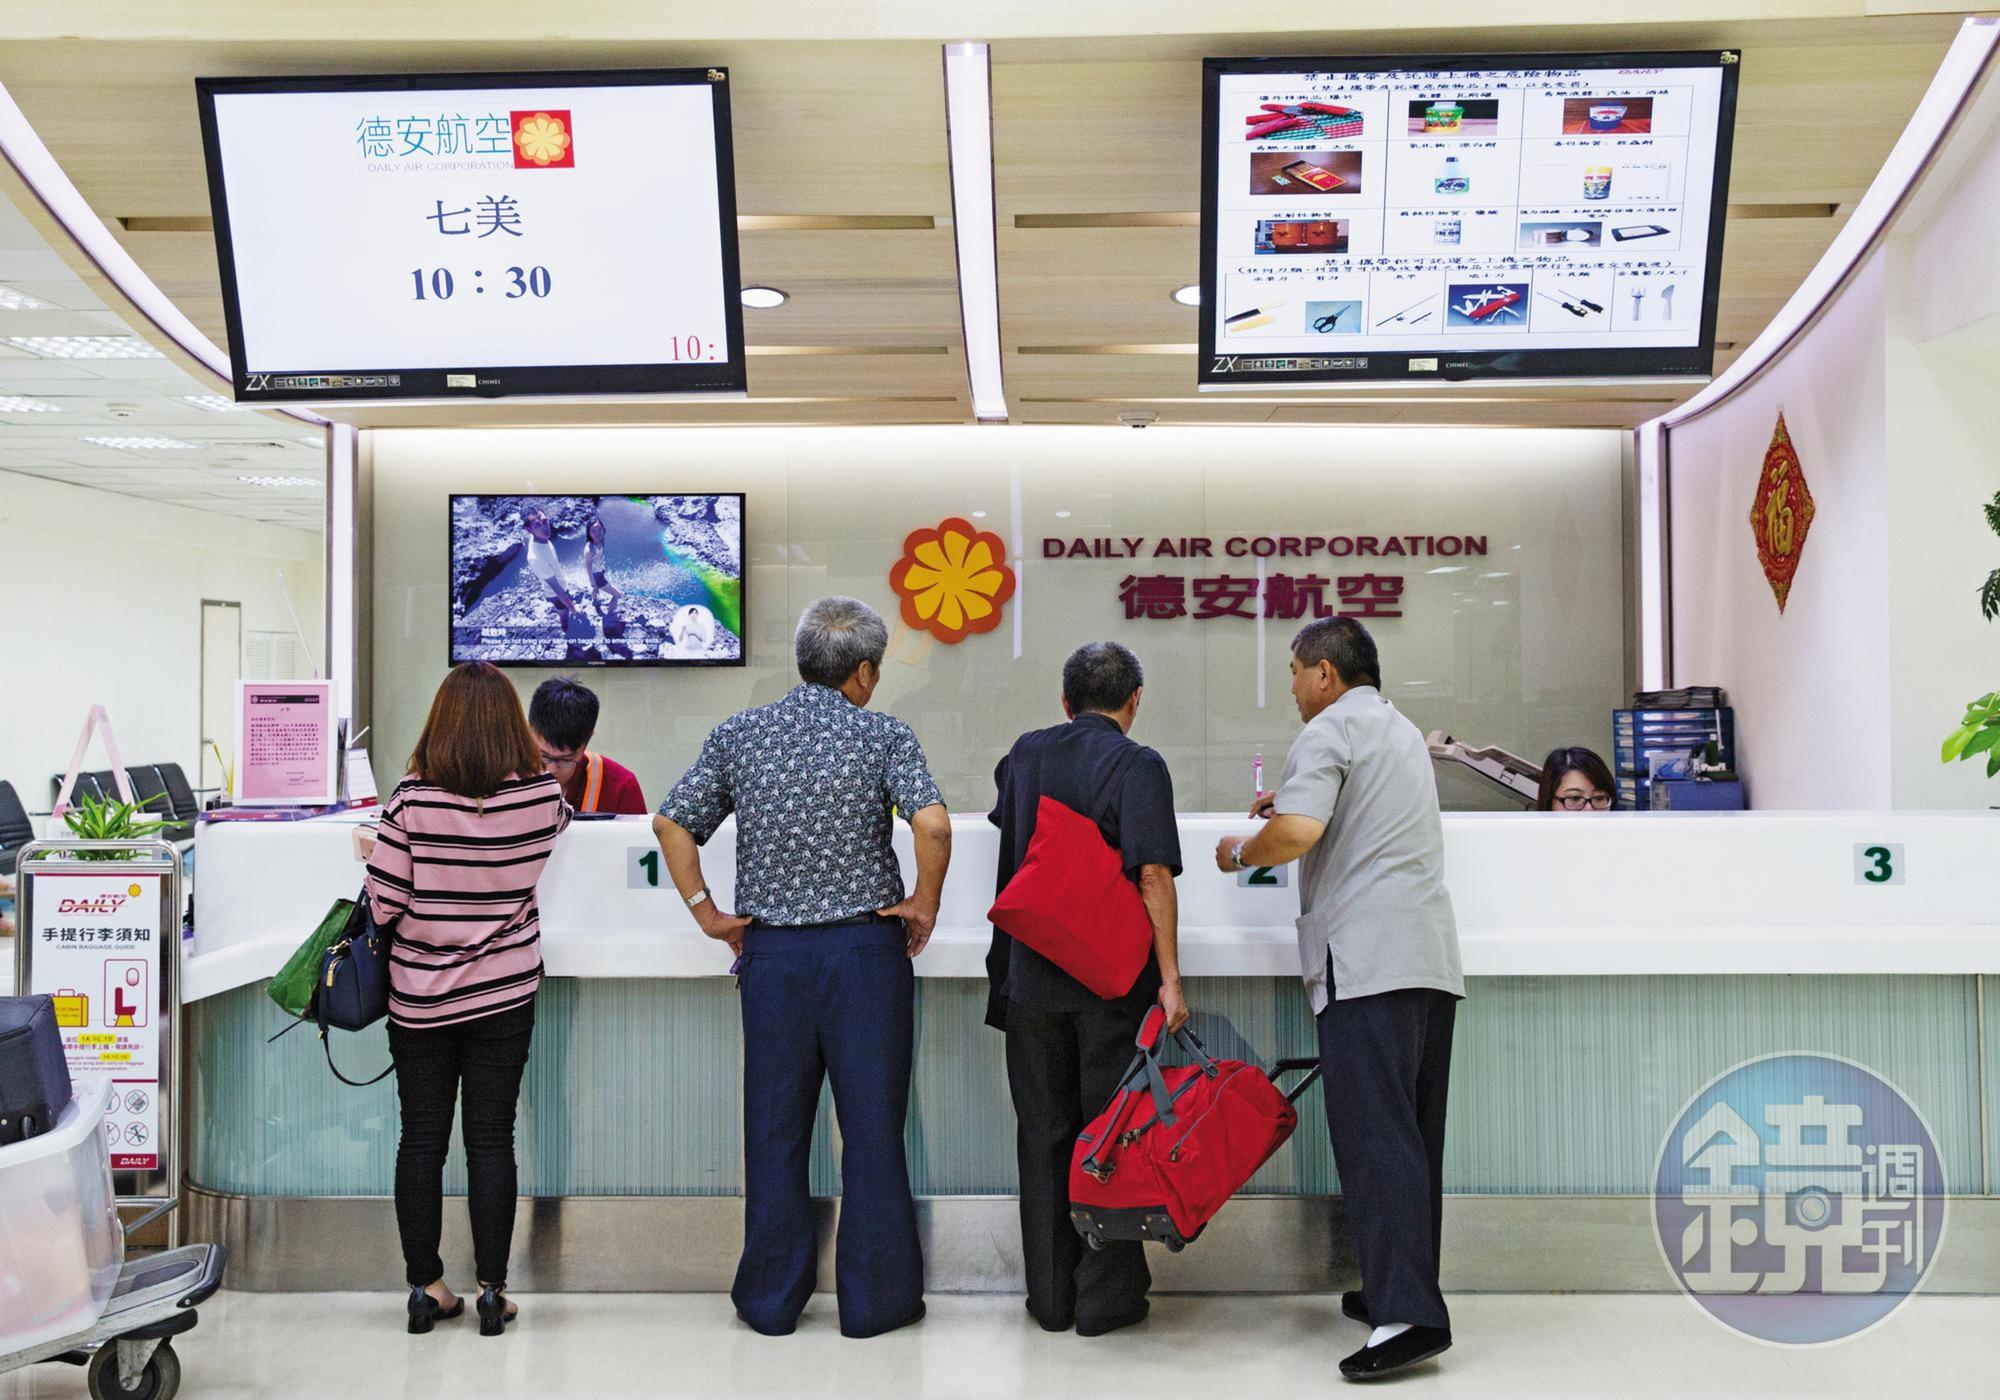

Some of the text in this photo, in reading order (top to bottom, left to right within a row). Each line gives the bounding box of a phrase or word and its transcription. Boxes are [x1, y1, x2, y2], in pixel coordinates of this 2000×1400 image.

[355, 112, 512, 158] 德安航空
[368, 160, 513, 173] DAILY AIR CORPORATION
[426, 193, 525, 239] 七美
[1043, 536, 1488, 558] DAILY AIR CORPORATION
[1119, 574, 1404, 620] 德安航空
[639, 850, 658, 887] 1
[1863, 846, 1893, 883] 3
[57, 898, 126, 913] DAILY
[42, 927, 151, 943] 手提行李須知
[120, 1157, 150, 1165] DAILY
